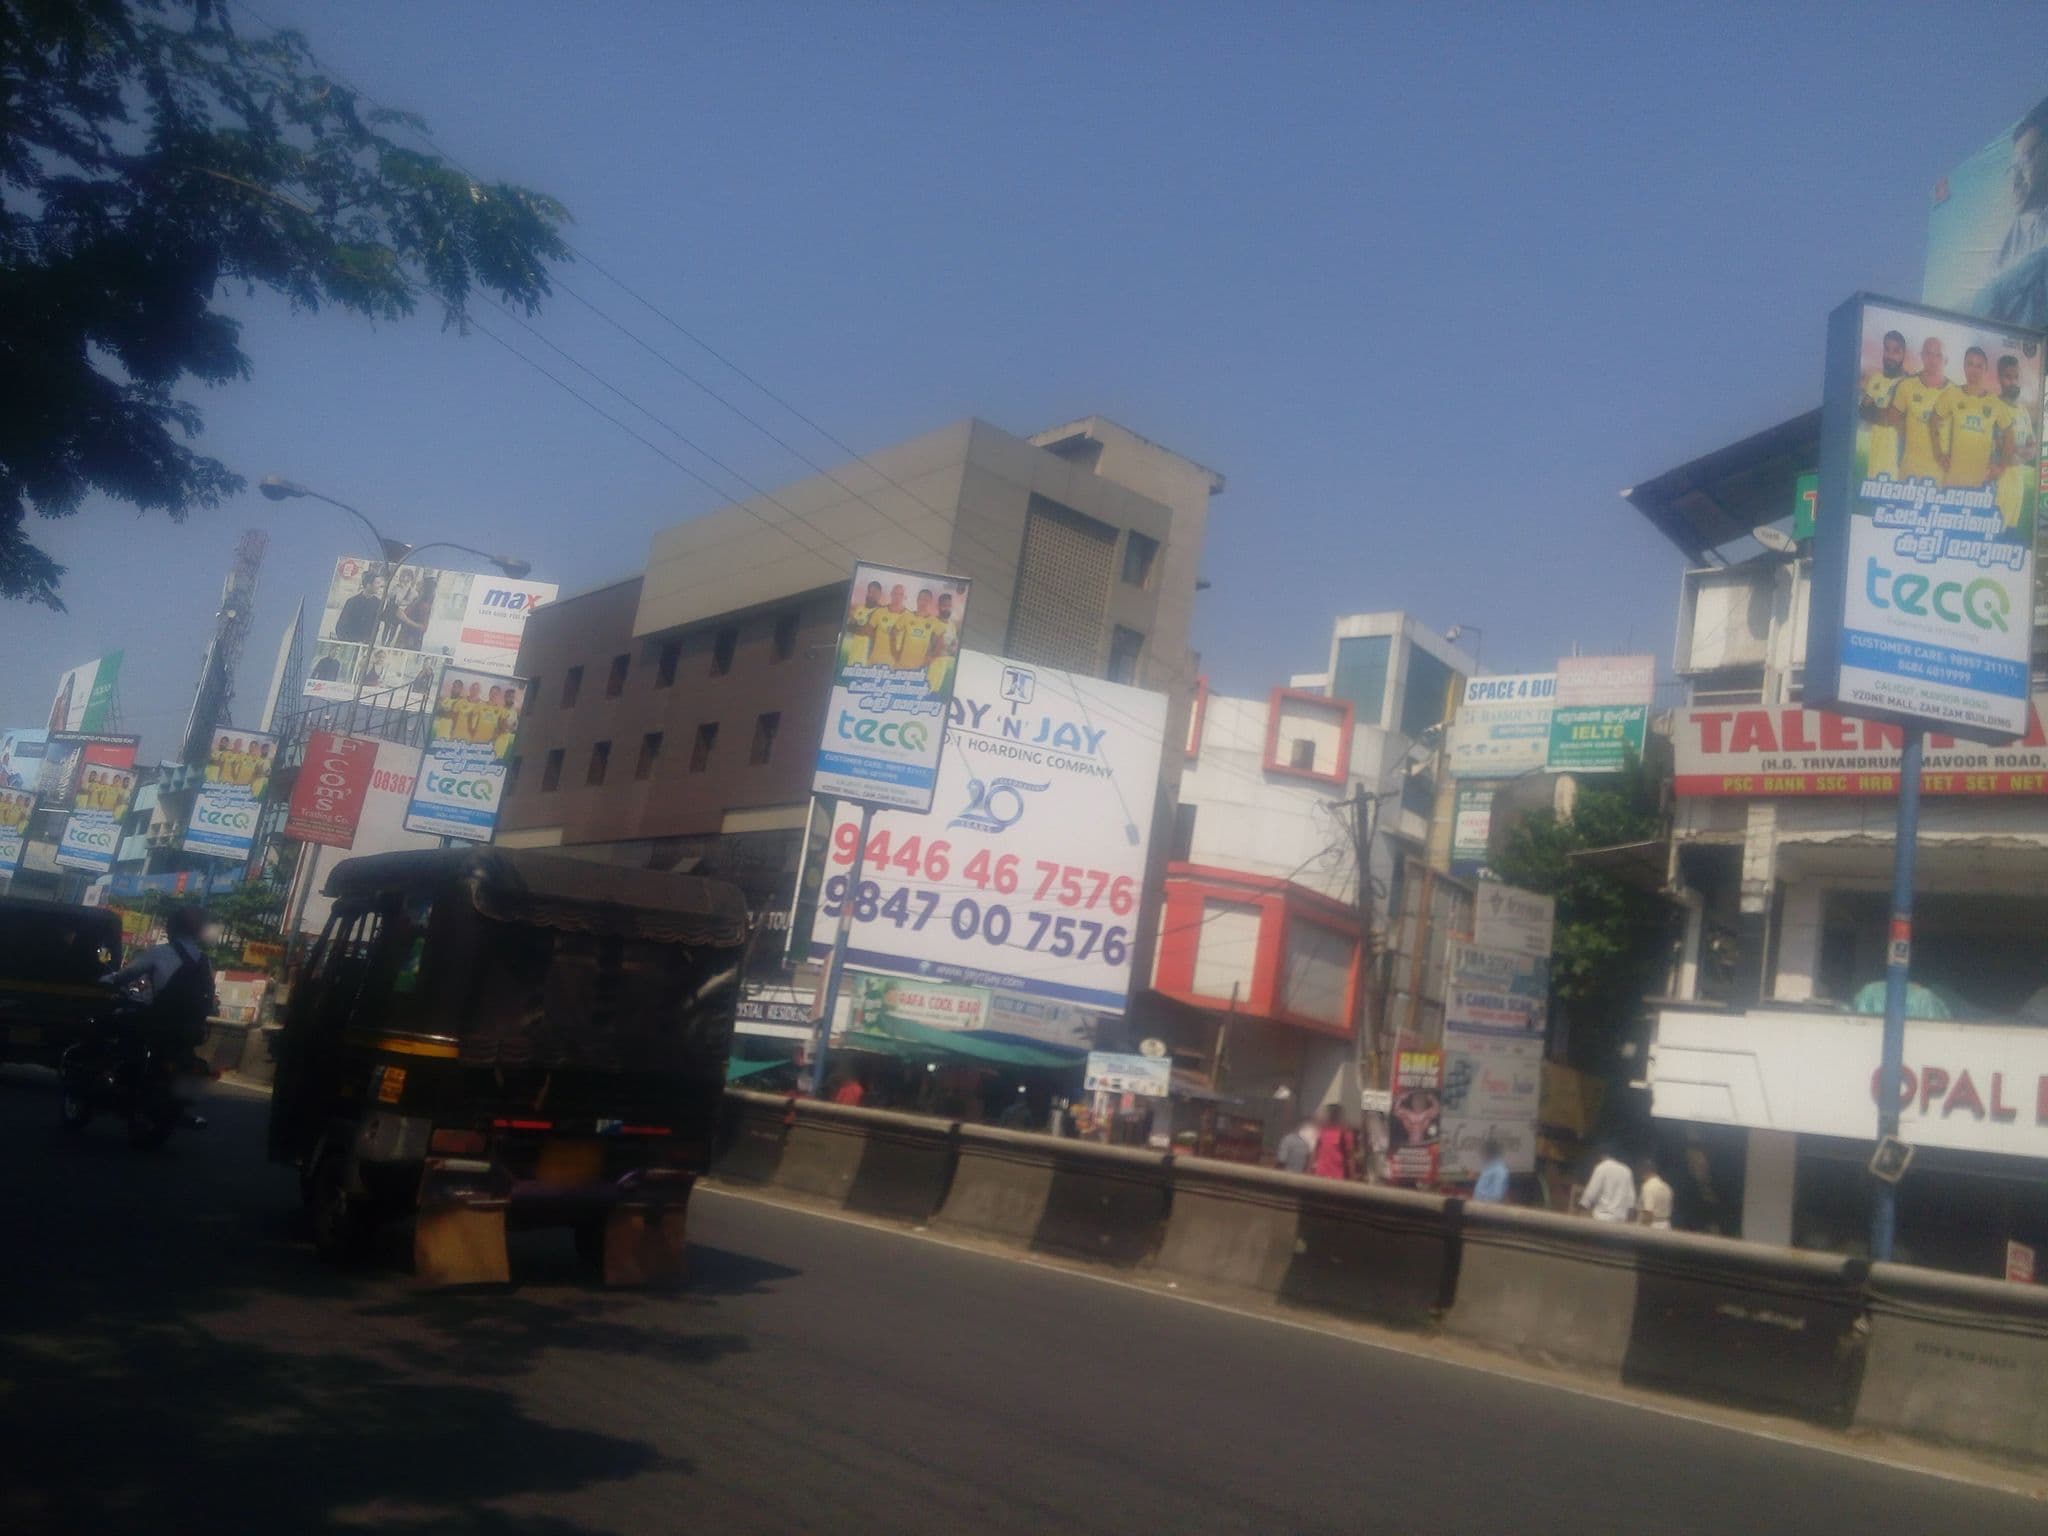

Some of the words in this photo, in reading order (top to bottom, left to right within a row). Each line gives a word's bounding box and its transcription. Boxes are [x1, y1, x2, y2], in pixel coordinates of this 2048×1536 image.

[483, 589, 542, 611] max
[1865, 555, 2010, 633] tecQ
[1851, 635, 1910, 656] CUSTOMER
[1913, 647, 1948, 664] CARE:
[1468, 680, 1515, 701] SPACE
[837, 709, 929, 752] tecQ
[947, 696, 992, 730] AY
[1032, 716, 1107, 754] JAY
[968, 738, 1042, 767] HOARDING
[1046, 754, 1114, 780] COMPANY
[1802, 757, 1902, 770] TRIVANDRUM
[1995, 754, 2047, 769] ROAD,
[426, 770, 494, 801] tecQ
[1723, 775, 1753, 792] PSC
[1816, 776, 1848, 791] SSC
[1966, 775, 1998, 791] SET
[198, 805, 250, 830] tecQ
[69, 828, 112, 848] tecQ
[832, 822, 952, 882] 9446
[963, 849, 1021, 895] 46
[1032, 860, 1134, 916] 7576
[822, 875, 941, 932] 9847
[950, 898, 1012, 945] 00
[1026, 911, 1128, 967] 7576
[1870, 1063, 2018, 1123] OPAL
